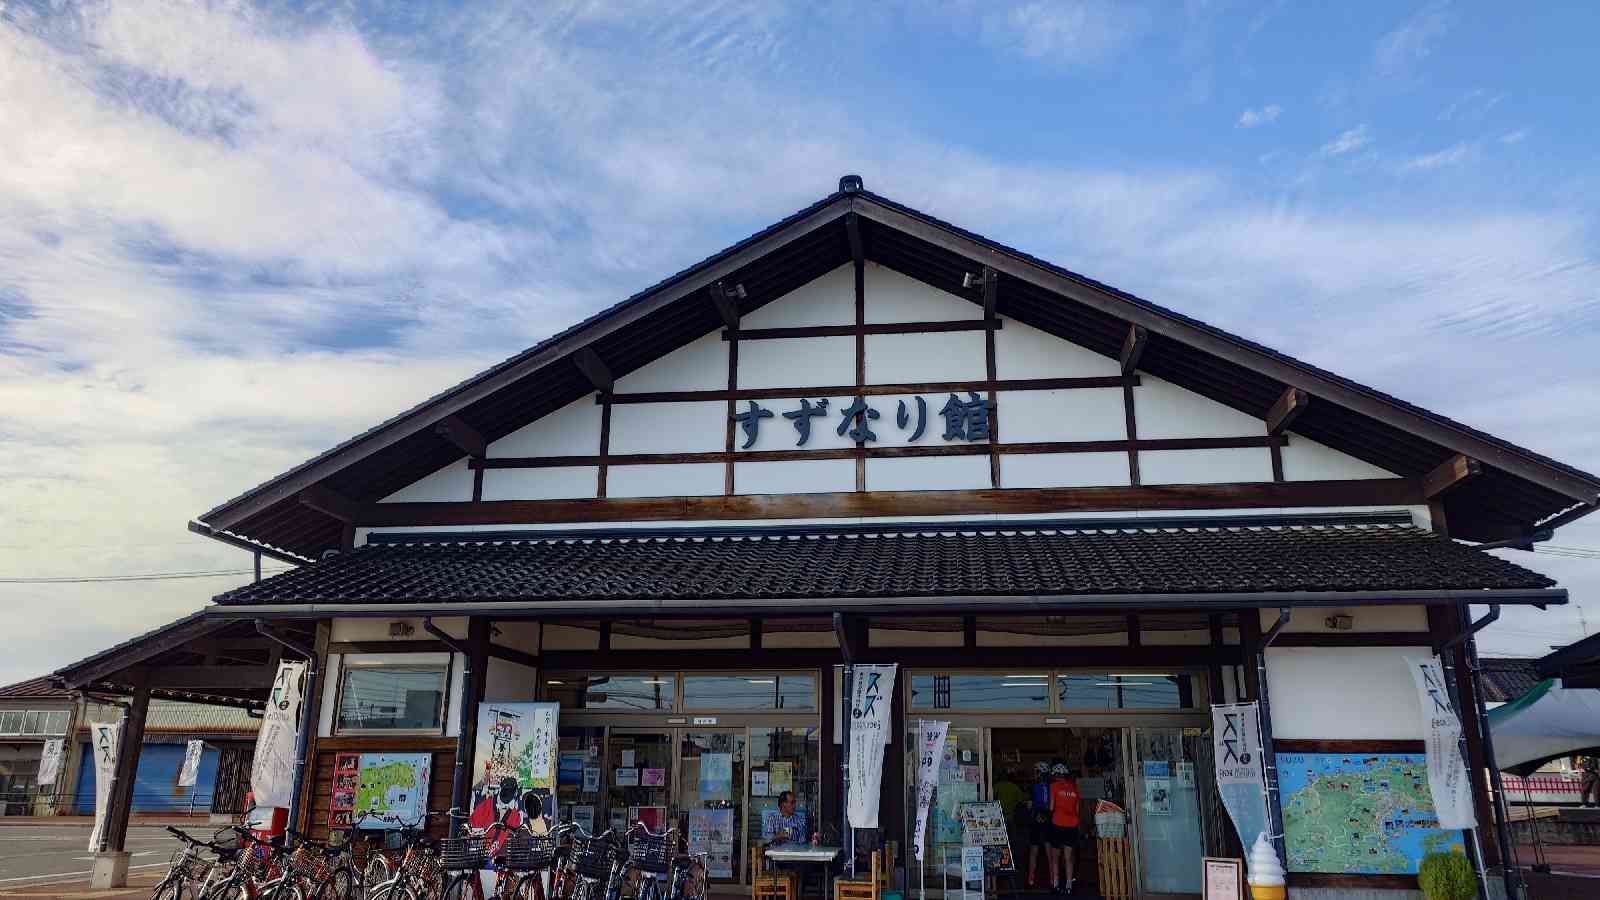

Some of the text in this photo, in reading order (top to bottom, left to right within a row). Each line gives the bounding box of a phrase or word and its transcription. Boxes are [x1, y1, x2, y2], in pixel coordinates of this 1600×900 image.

[729, 391, 992, 449] すずなり館
[863, 672, 882, 719] スズ
